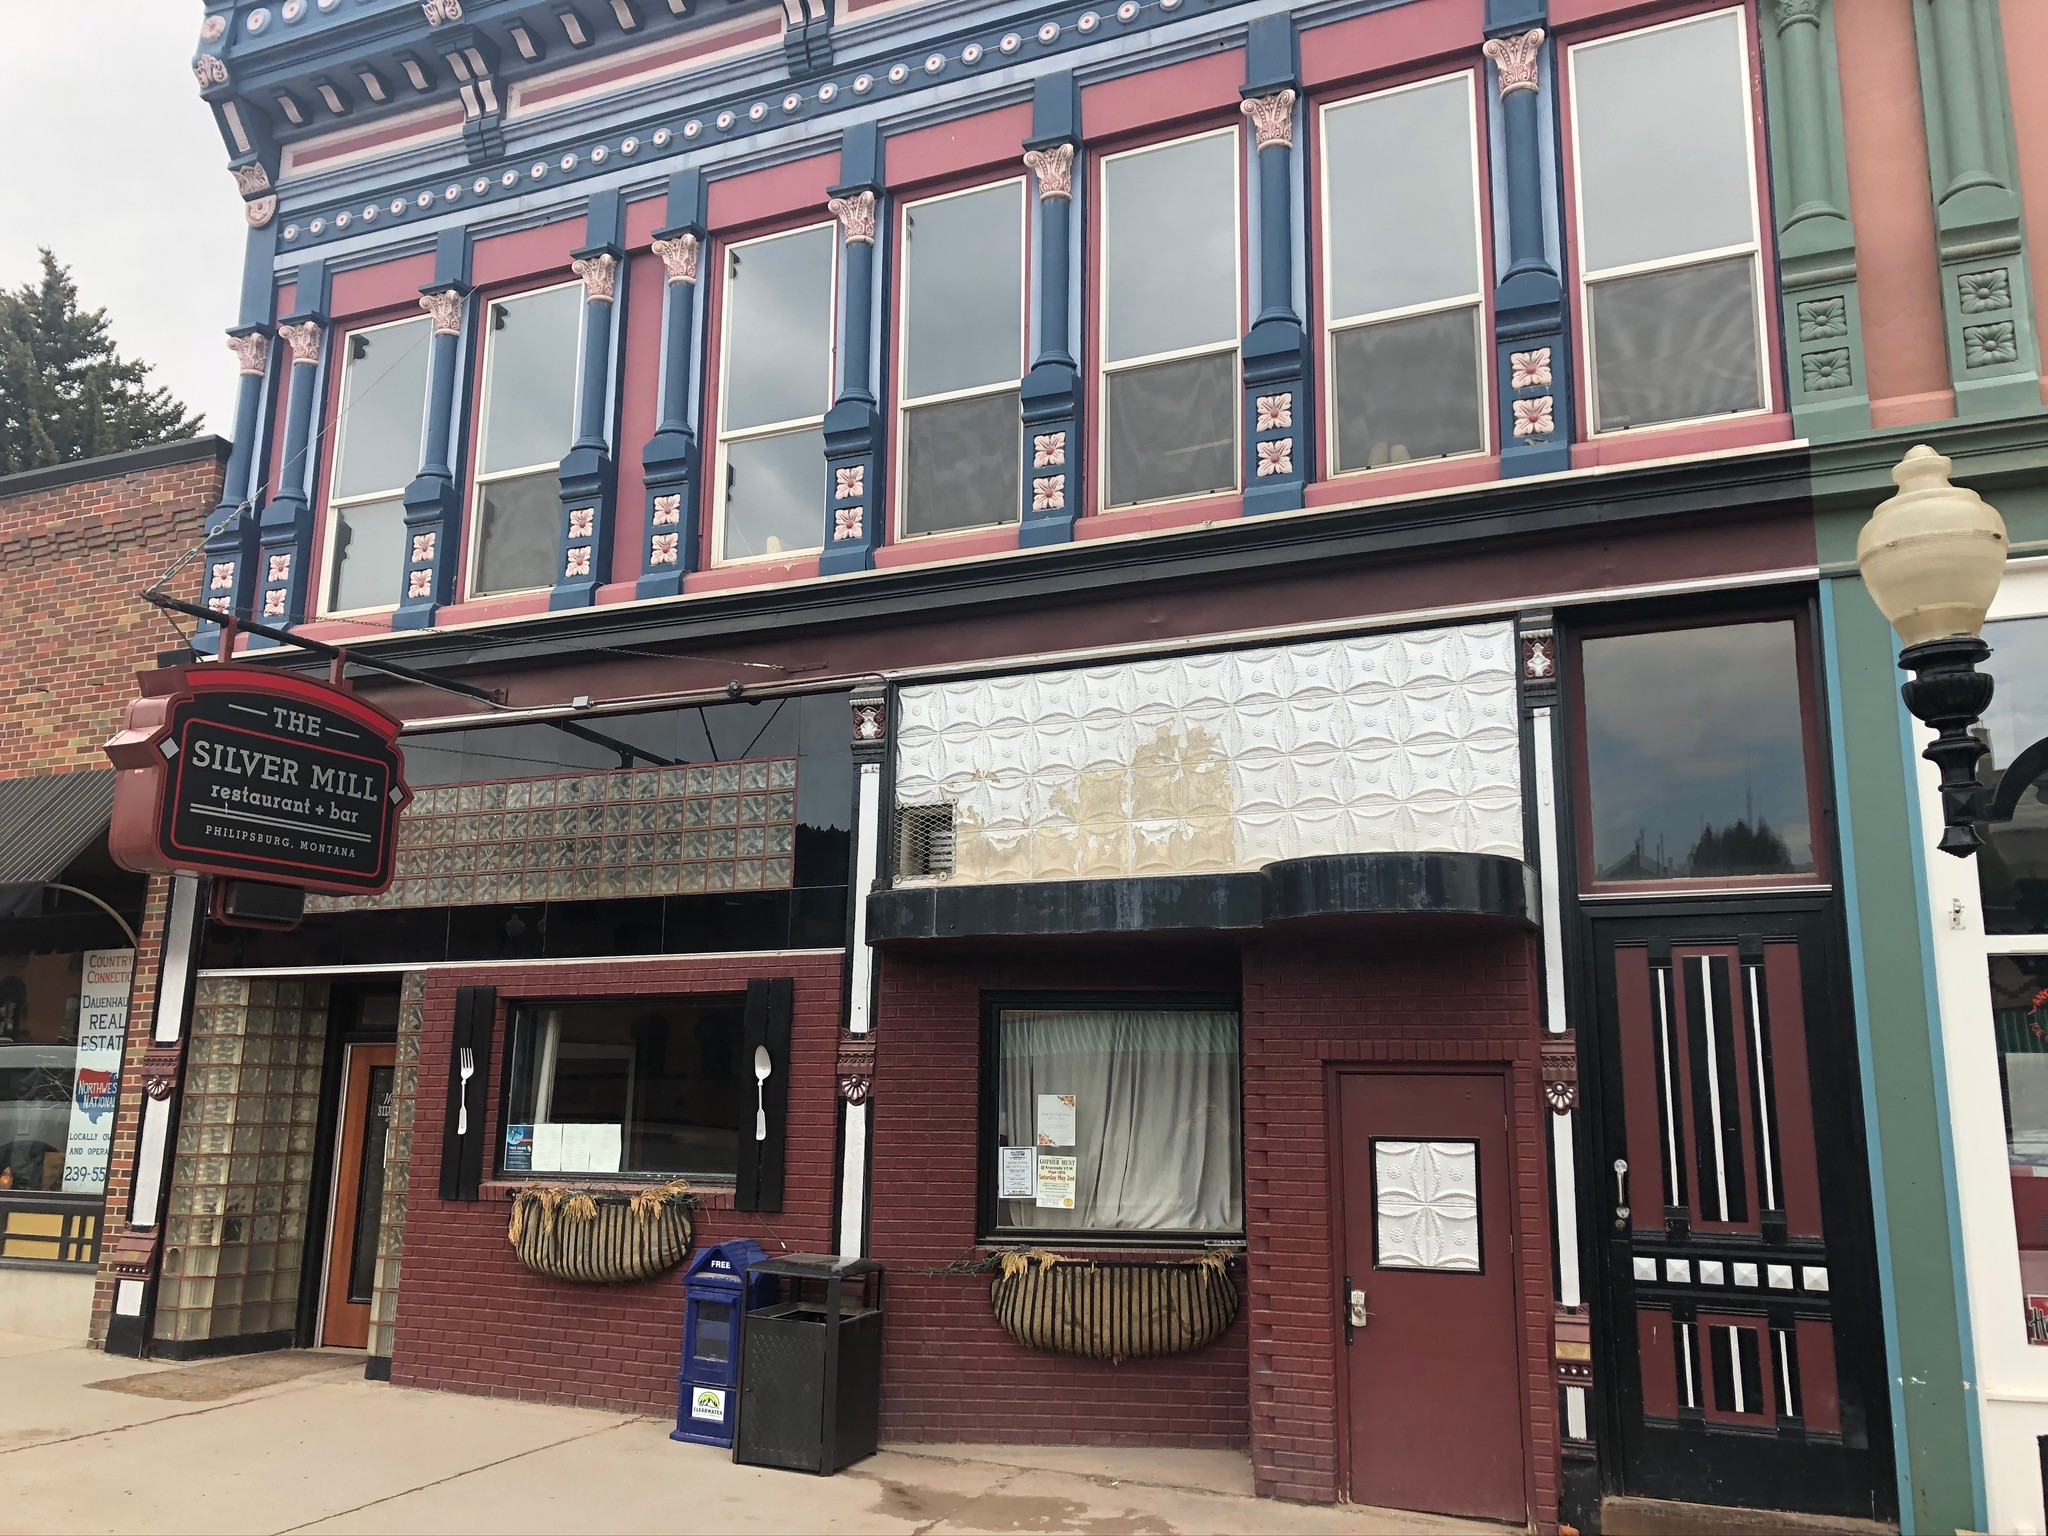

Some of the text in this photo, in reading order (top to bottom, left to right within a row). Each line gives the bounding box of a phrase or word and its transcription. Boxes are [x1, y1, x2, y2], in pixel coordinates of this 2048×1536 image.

[273, 707, 321, 737] THE
[192, 740, 378, 801] SILVER MILL
[210, 785, 311, 815] restaurant
[329, 801, 359, 823] bar
[205, 825, 356, 858] PHILIPSBURG, MONTANA
[89, 1014, 126, 1030] REAL
[69, 1133, 99, 1141] LOCALLY
[69, 1148, 84, 1156] AND
[1039, 1173, 1057, 1181] Saturday
[711, 1260, 731, 1269] FREE
[693, 1407, 723, 1416] CLEARWATER
